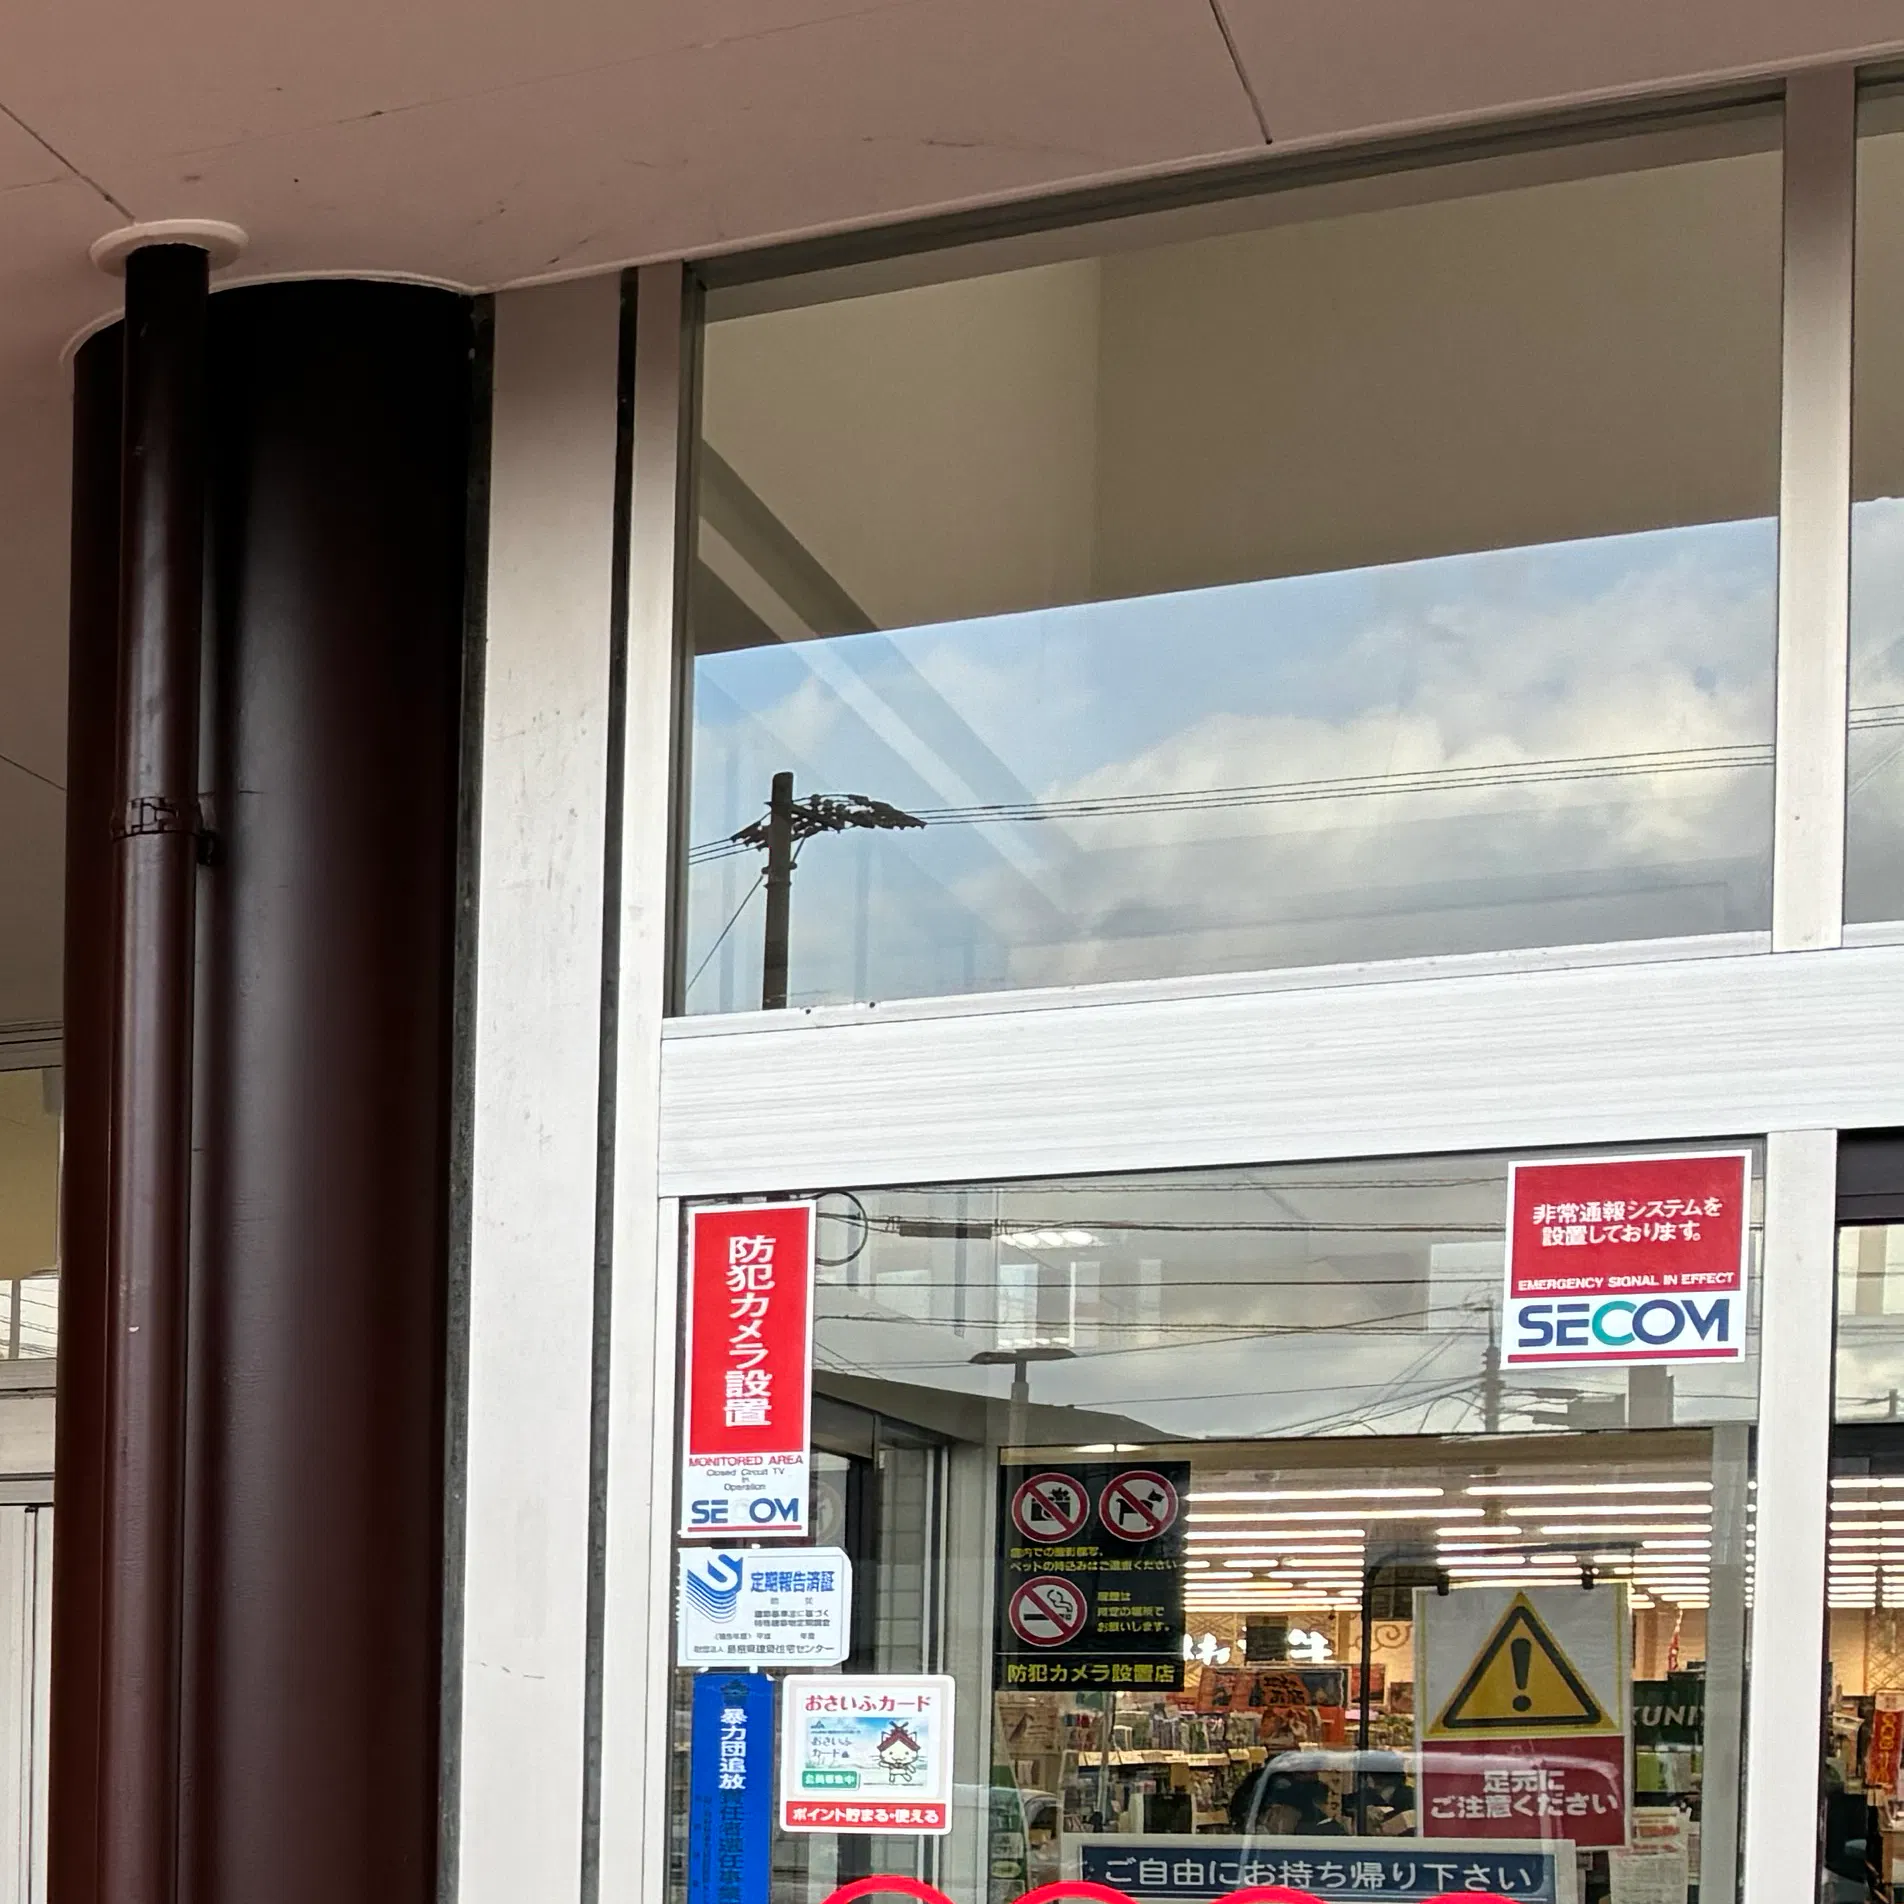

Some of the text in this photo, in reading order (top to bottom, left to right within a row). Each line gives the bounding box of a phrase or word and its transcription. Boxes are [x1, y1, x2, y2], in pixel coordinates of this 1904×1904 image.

[1532, 1197, 1723, 1225] 非常通報システムを
[1542, 1219, 1702, 1247] 設置しております。
[1518, 1272, 1734, 1291] EMERGENCY SIGNAL IN EFFECT
[724, 1236, 776, 1427] 防犯カメラ設置
[1518, 1298, 1730, 1348] SECOM
[689, 1455, 804, 1467] MONITORED AREA
[773, 1467, 785, 1475] TV
[751, 1571, 835, 1593] 定期報告済証
[1007, 1664, 1175, 1683] 防犯カメラ設置店
[805, 1695, 932, 1712] おさいふカード
[1483, 1769, 1565, 1793] 足元に
[793, 1807, 939, 1824] ポイント貯まる・使える
[1430, 1793, 1619, 1820] ご注意ください
[1105, 1857, 1531, 1892] ご自由にお持ち帰り下さい
